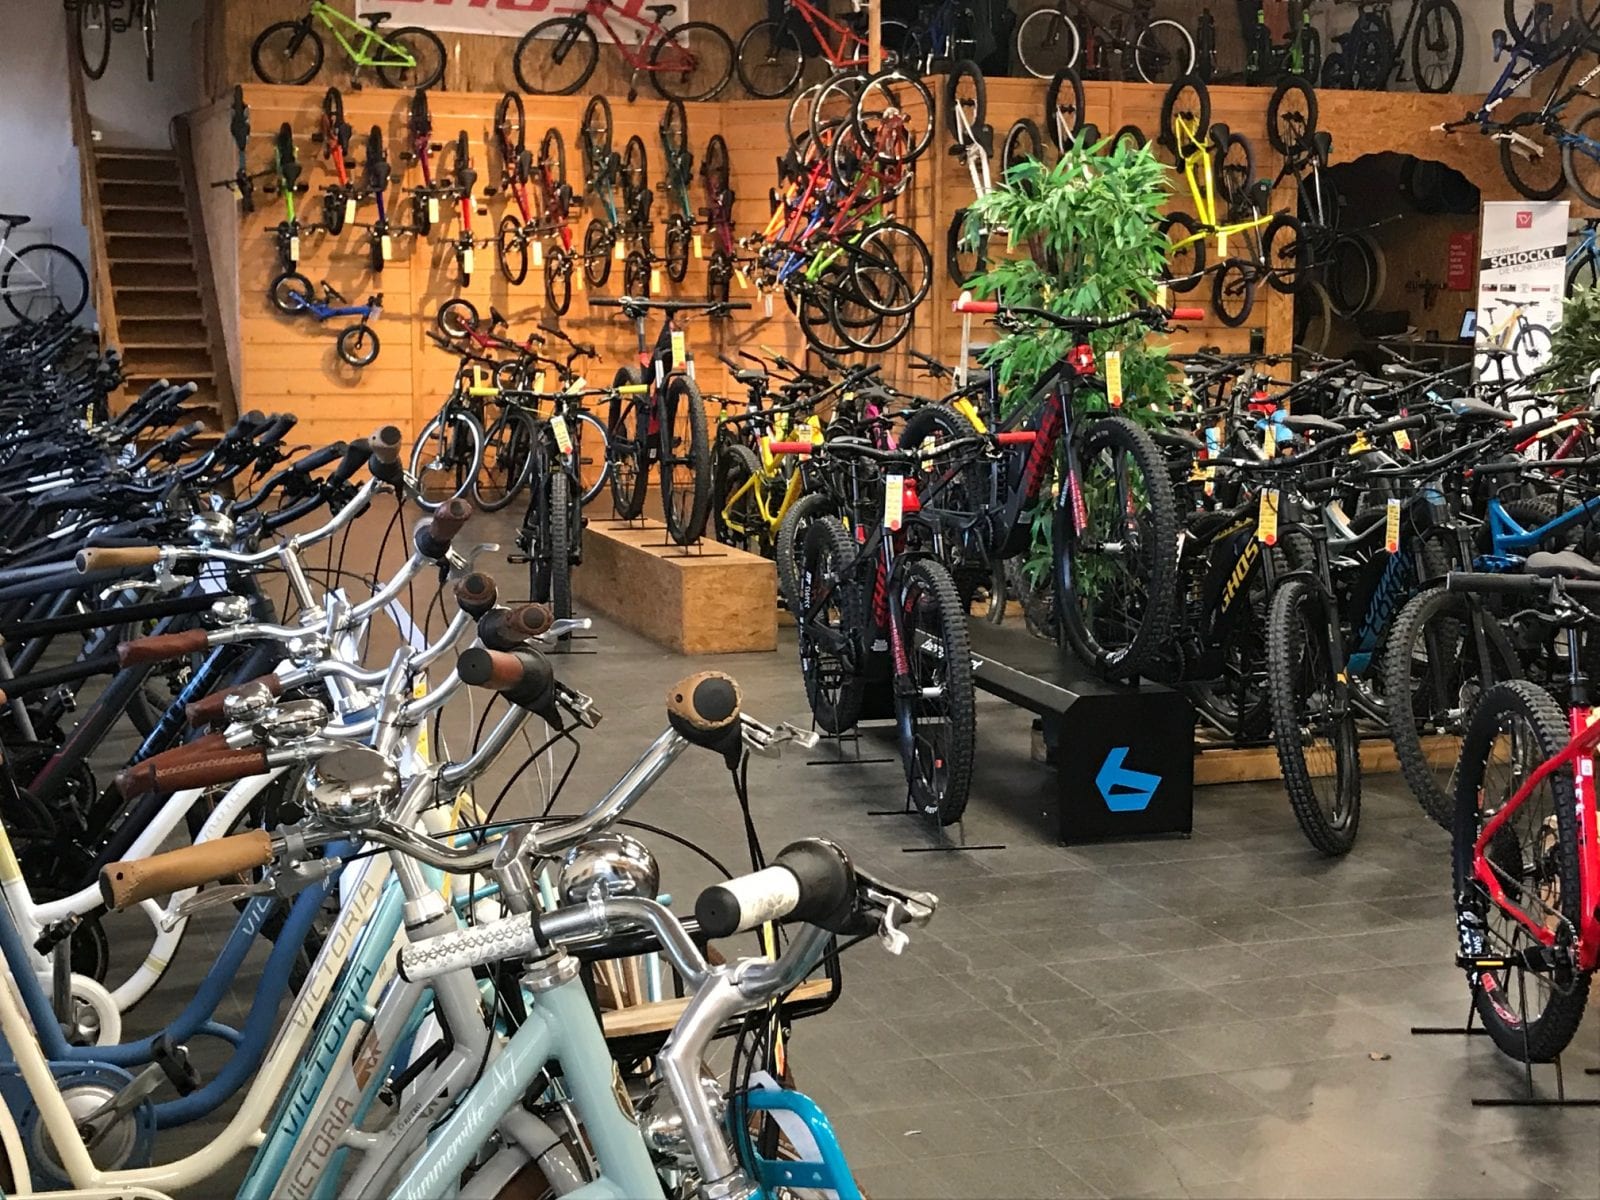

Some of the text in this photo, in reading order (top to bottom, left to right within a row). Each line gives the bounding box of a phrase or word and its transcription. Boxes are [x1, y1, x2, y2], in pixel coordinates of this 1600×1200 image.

[1490, 247, 1555, 269] SCHOCKT
[1221, 528, 1260, 613] GHOS
[292, 880, 375, 1029] VICTORIA
[281, 966, 373, 1137] VICTORIA
